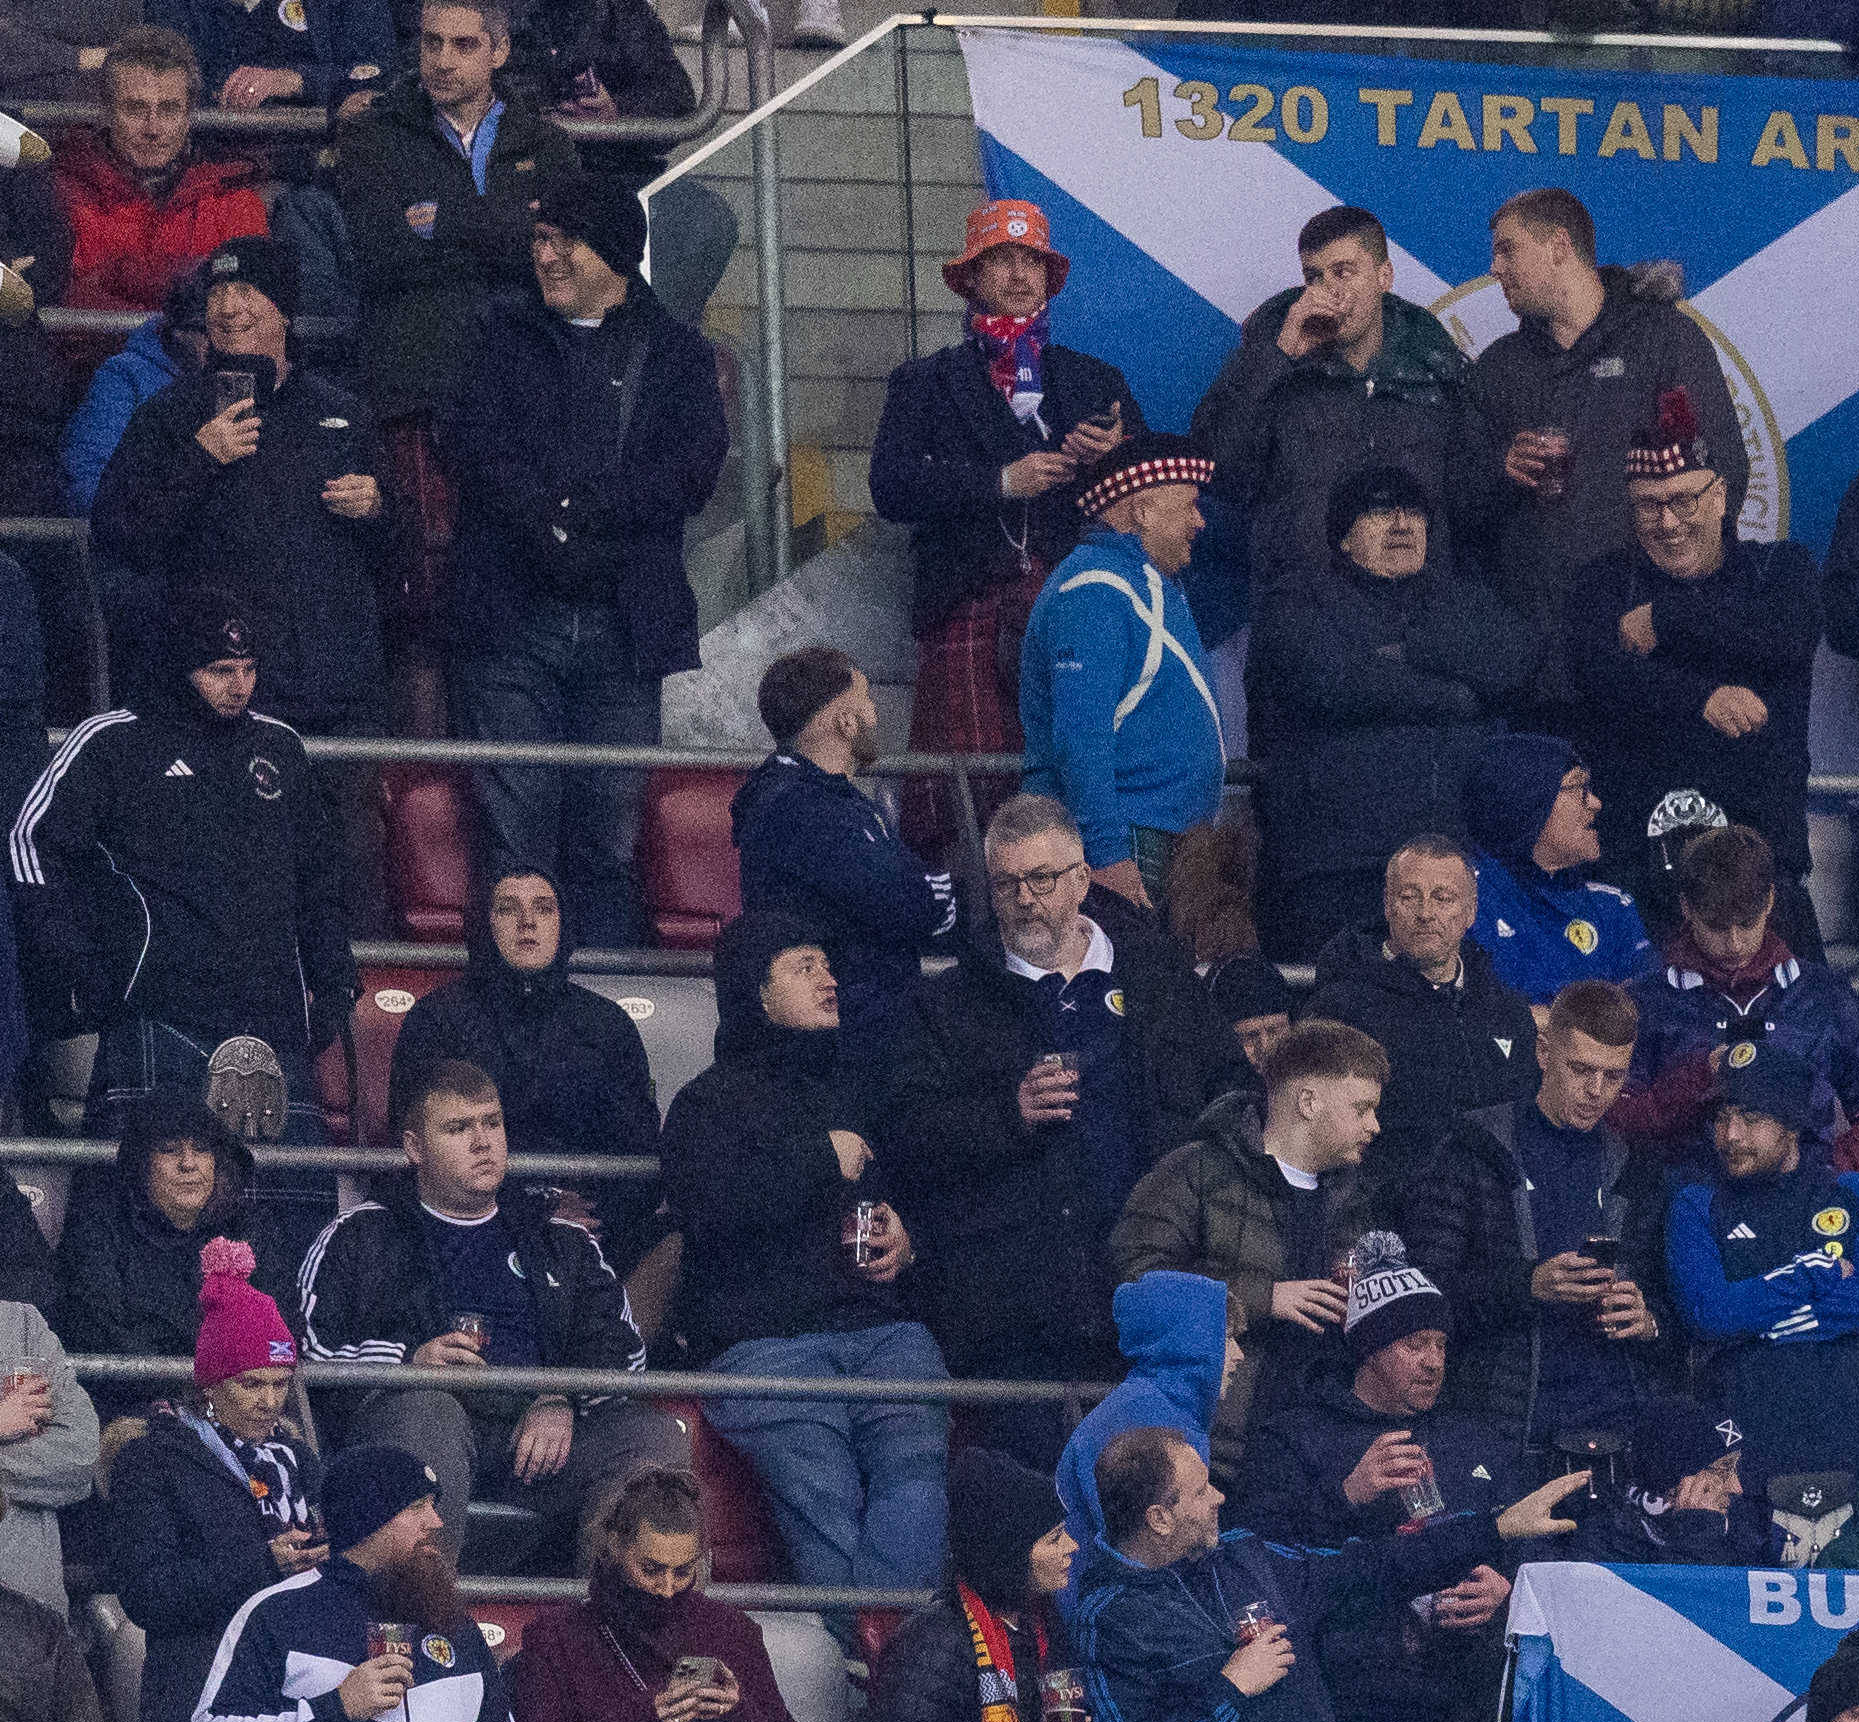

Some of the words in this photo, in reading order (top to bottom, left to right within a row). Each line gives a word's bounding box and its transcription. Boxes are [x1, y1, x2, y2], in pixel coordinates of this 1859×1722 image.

[1122, 77, 1329, 146] 1320
[1359, 87, 1720, 167] TARTAN
[1353, 1270, 1436, 1310] SCOTL
